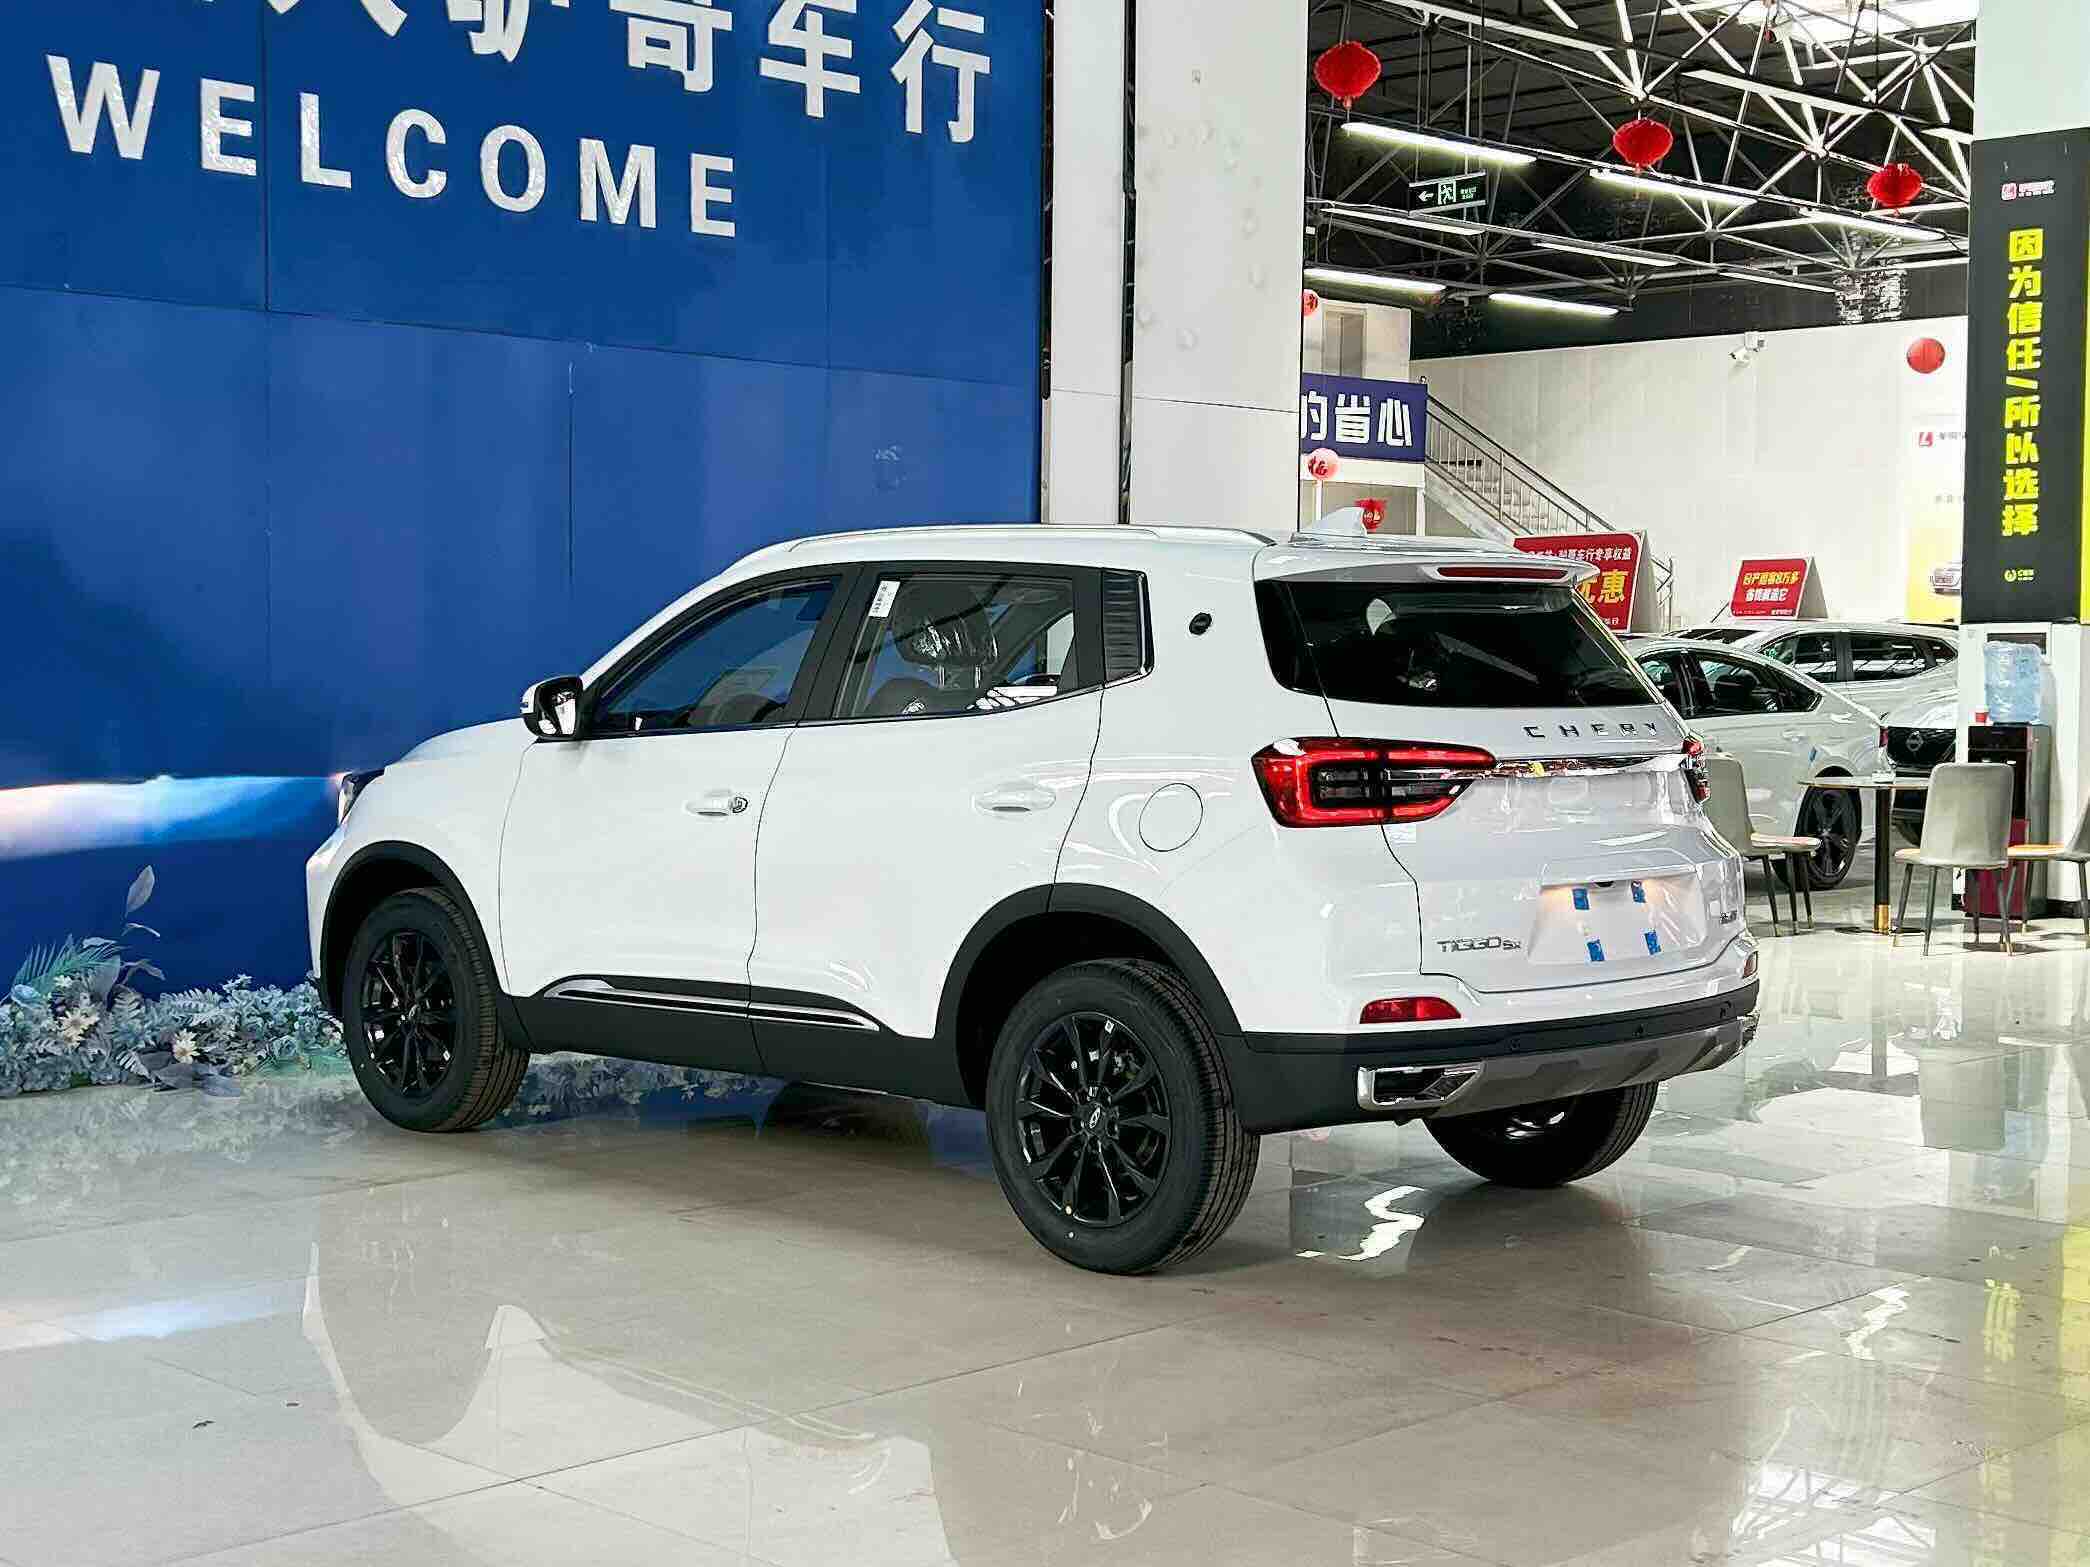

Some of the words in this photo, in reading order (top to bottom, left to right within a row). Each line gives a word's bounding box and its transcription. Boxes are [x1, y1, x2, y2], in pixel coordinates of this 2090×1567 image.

[46, 55, 736, 238] WELCOME
[2002, 228, 2044, 536] 因为信任/所以选择
[1522, 721, 1657, 739] CHERY
